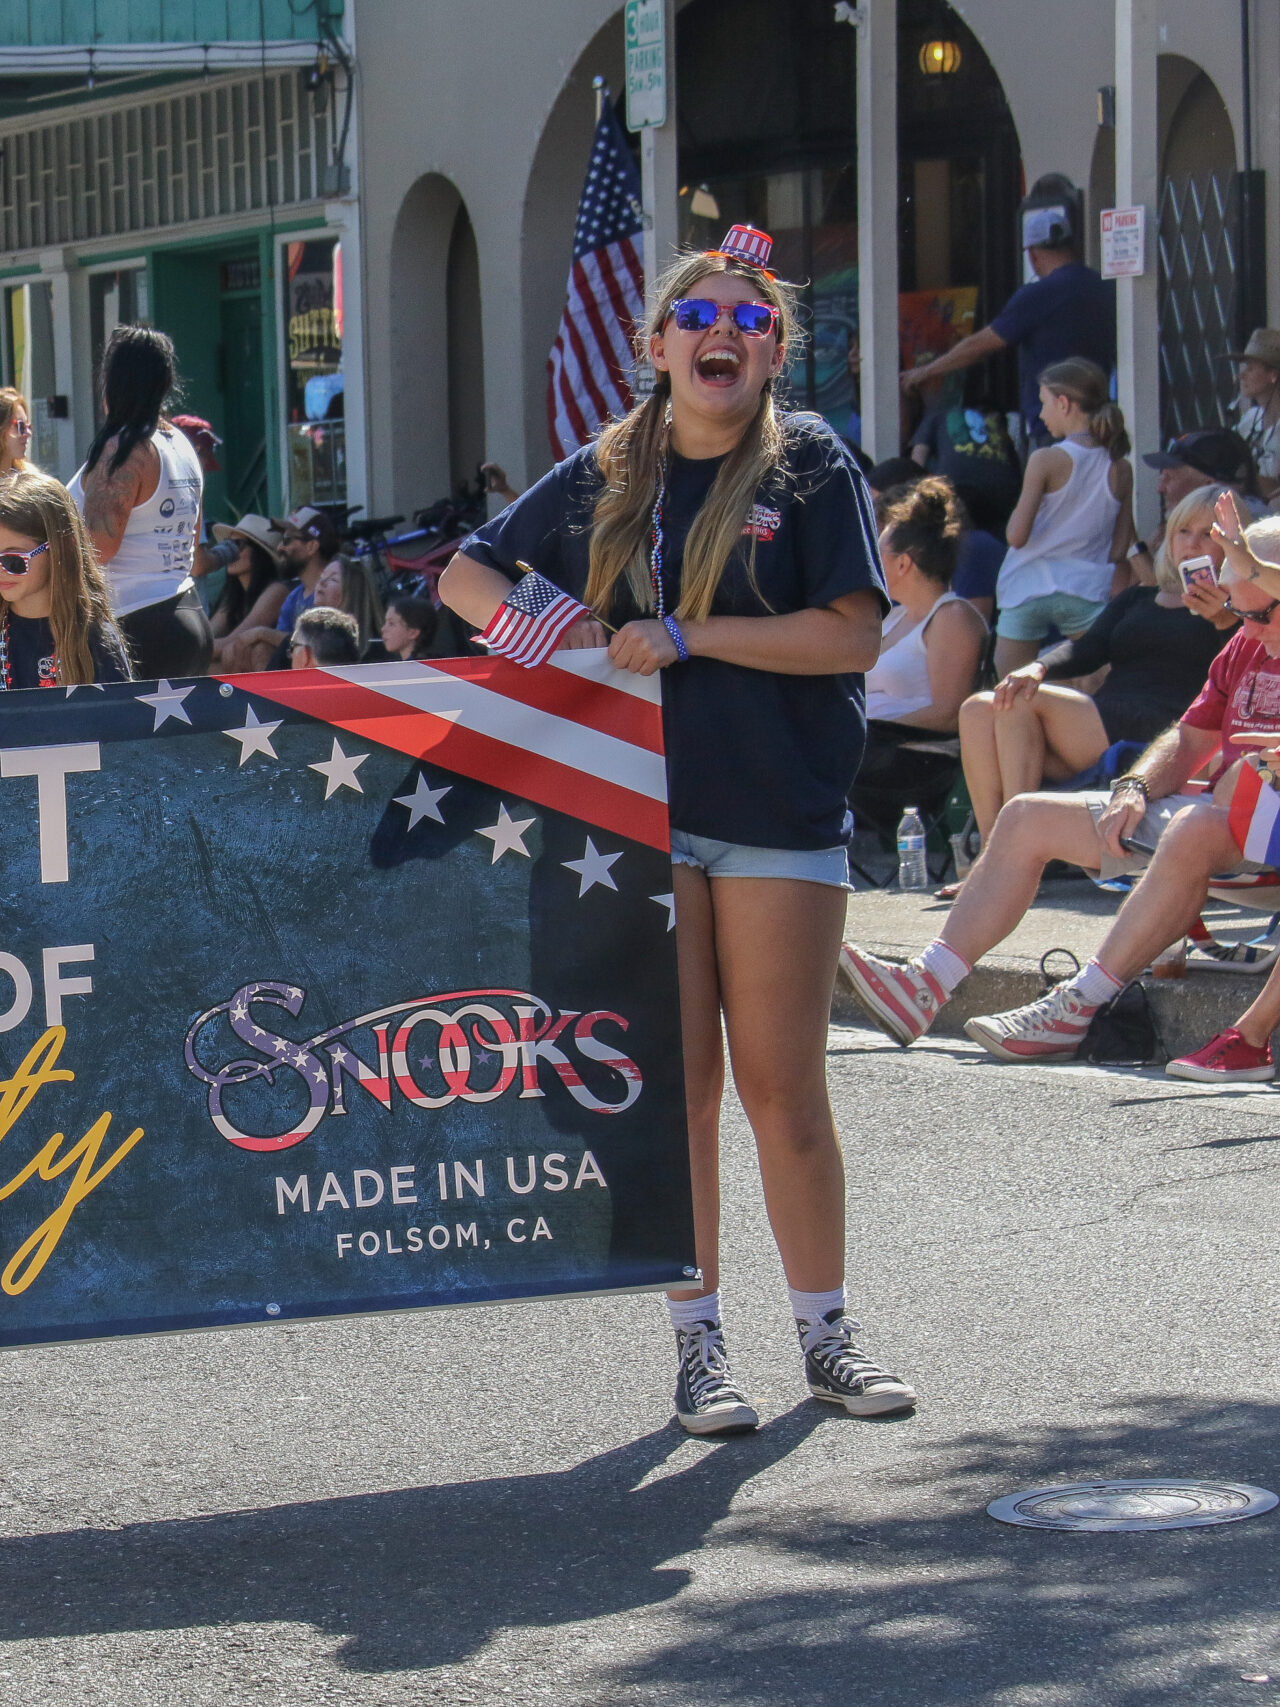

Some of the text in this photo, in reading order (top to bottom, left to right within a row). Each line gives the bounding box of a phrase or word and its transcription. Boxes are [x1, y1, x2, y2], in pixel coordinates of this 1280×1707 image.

[627, 10, 637, 41] 3
[184, 981, 643, 1152] SNOOKS
[275, 1149, 608, 1215] MADE IN USA
[336, 1217, 554, 1258] FOLSOM, CA
